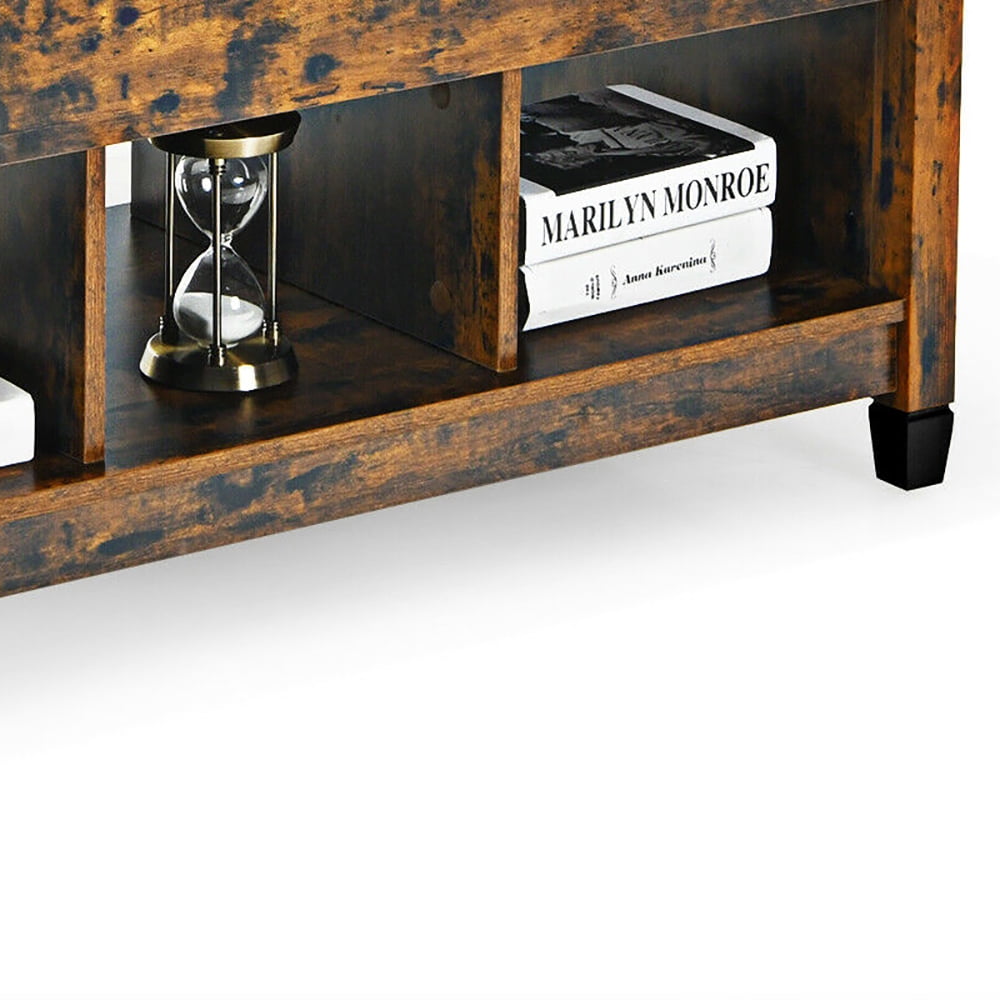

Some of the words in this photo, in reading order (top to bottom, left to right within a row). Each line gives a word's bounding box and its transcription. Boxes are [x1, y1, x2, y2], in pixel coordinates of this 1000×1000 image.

[541, 189, 656, 246] MARILYN
[663, 163, 770, 217] MONROE
[622, 271, 653, 286] Anna
[655, 254, 707, 276] Karenina
